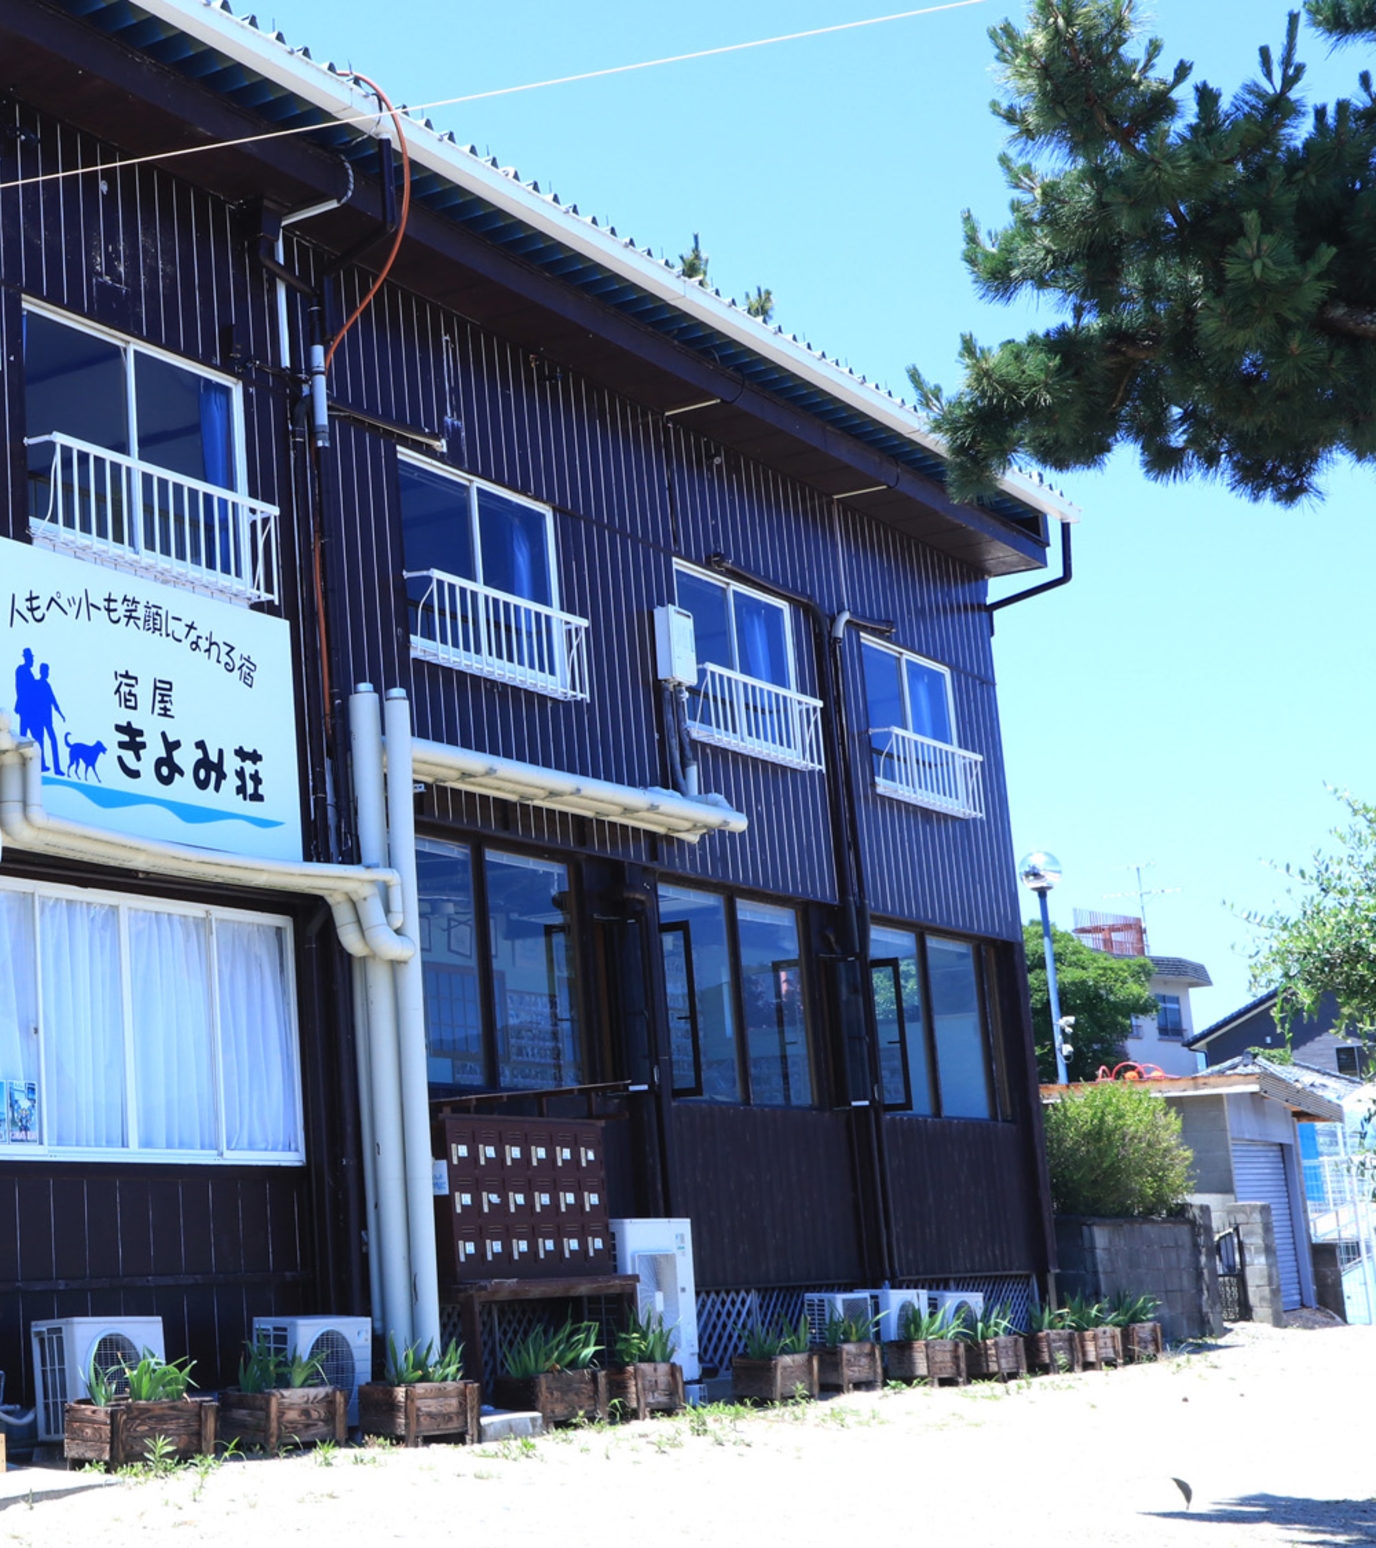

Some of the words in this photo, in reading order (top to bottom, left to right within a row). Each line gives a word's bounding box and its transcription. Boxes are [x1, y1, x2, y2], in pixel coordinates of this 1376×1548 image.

[9, 588, 258, 690] 人もペットも笑顔になれる宿
[113, 669, 175, 719] 宿屋
[113, 721, 265, 803] きよみ荘
